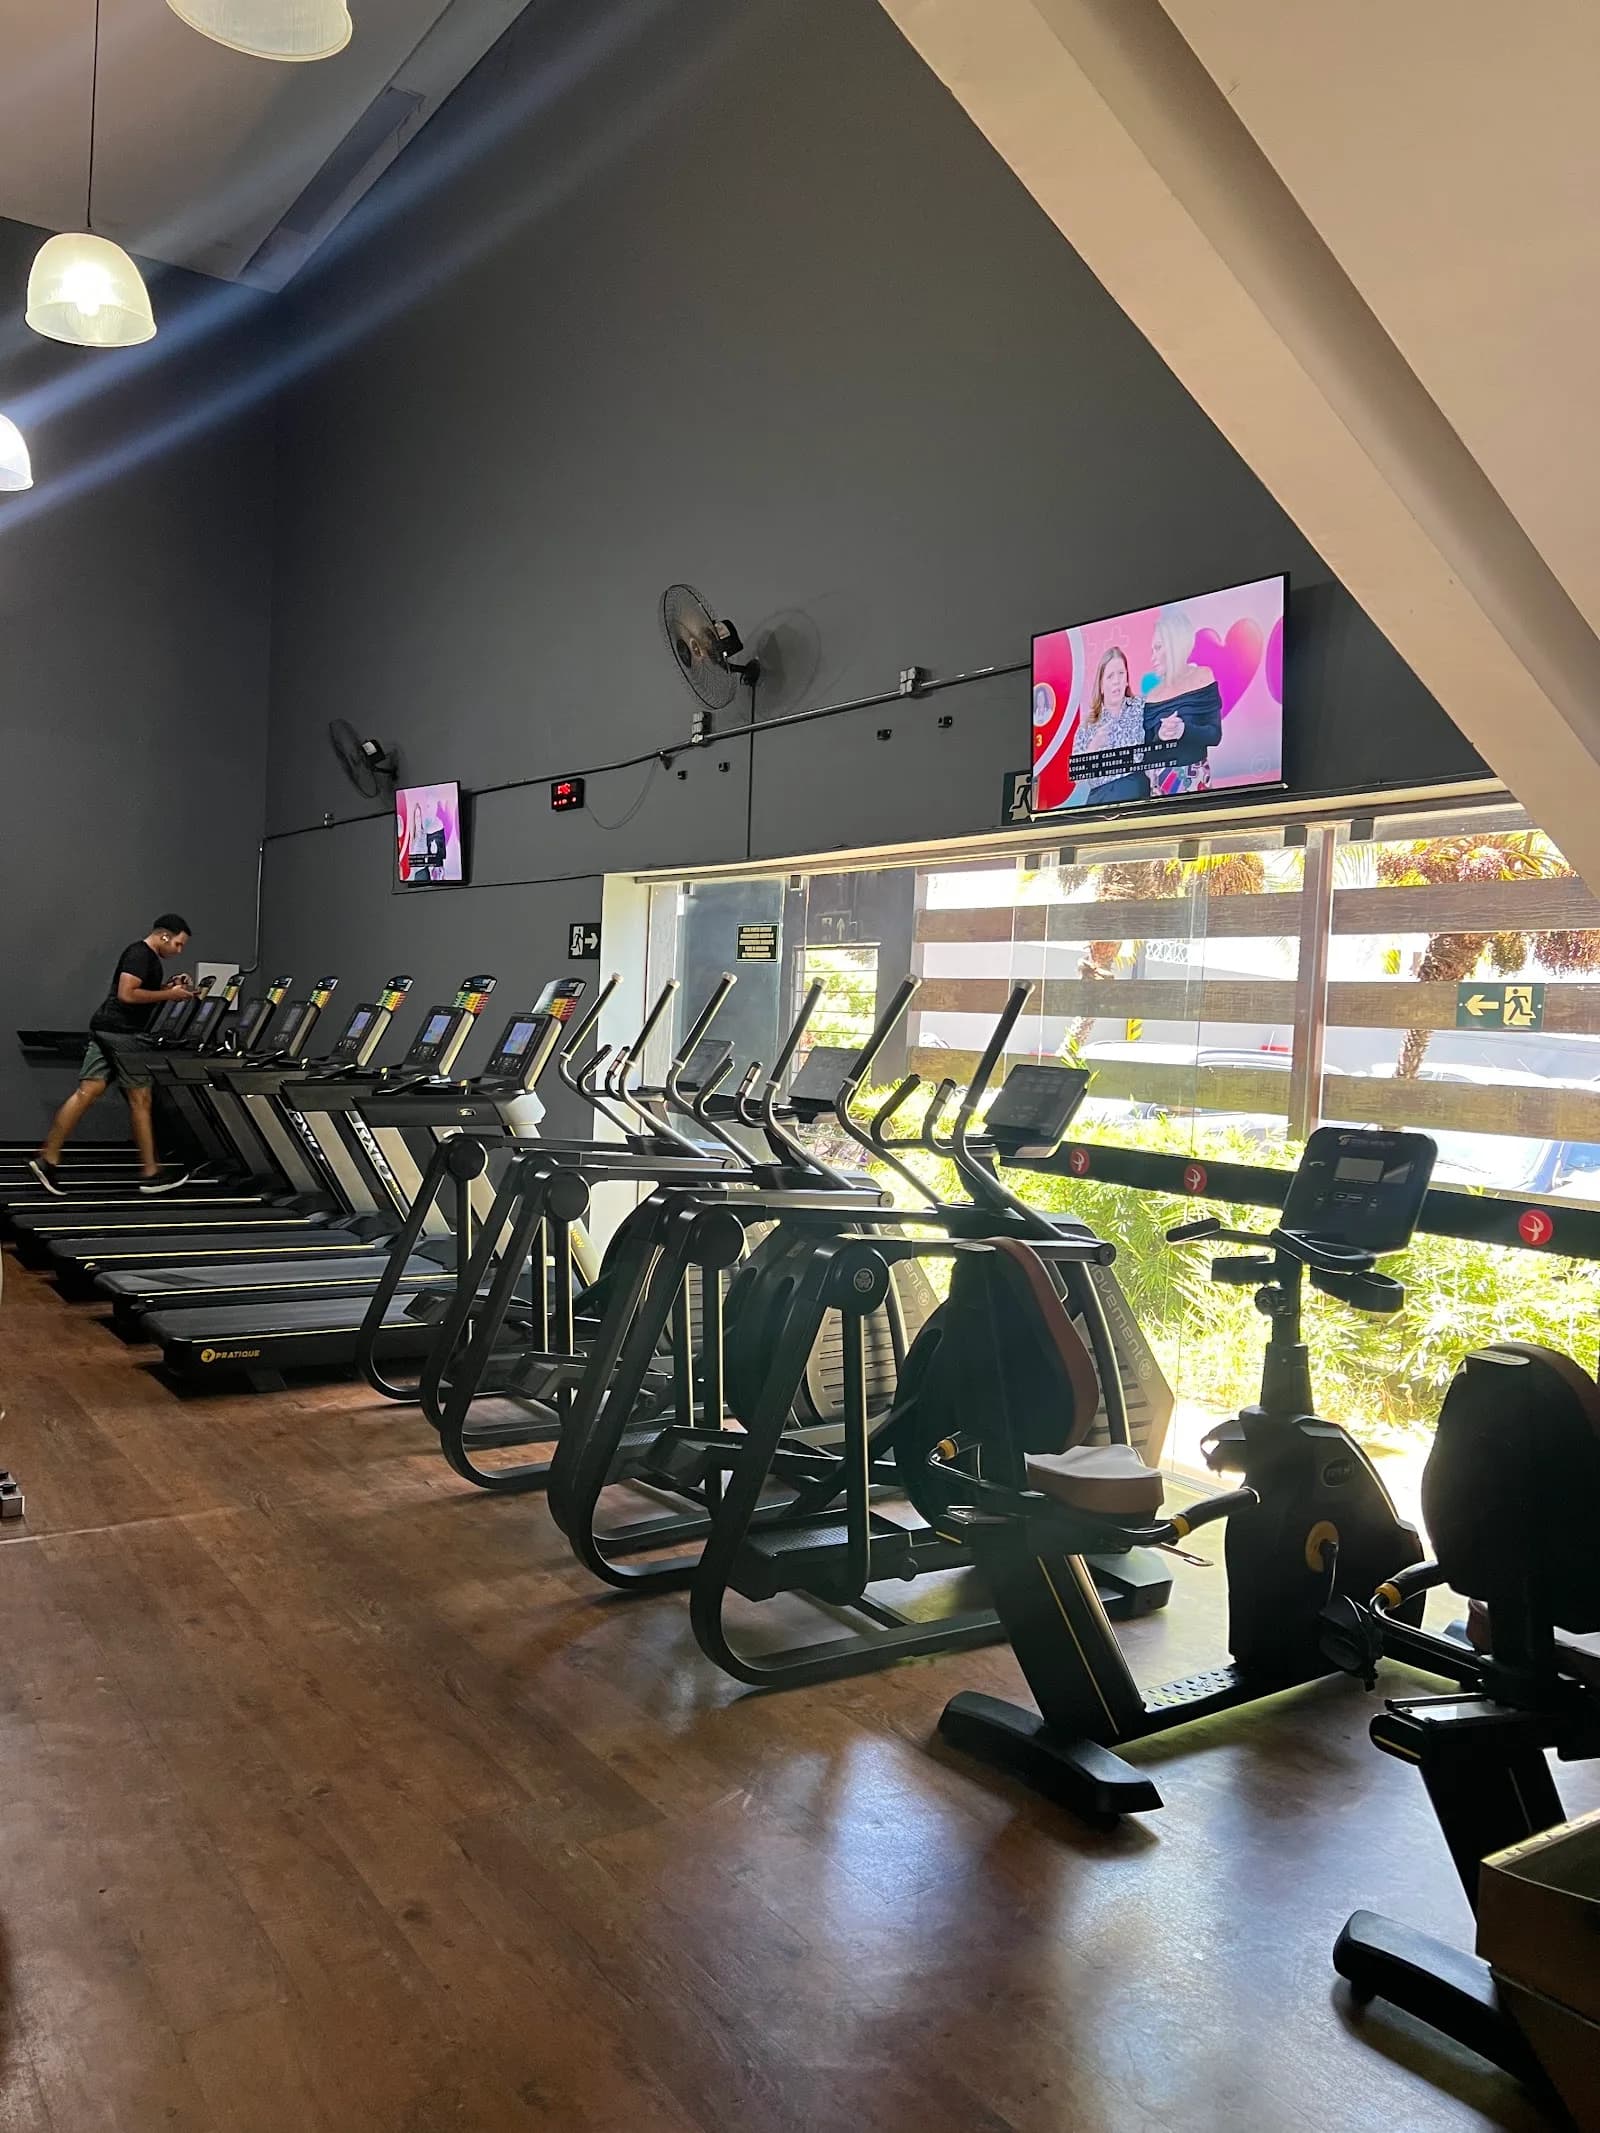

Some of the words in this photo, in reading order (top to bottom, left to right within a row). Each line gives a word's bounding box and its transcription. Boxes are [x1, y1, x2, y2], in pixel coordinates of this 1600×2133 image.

[1035, 734, 1043, 747] 3
[1102, 751, 1116, 759] CADA
[215, 1349, 261, 1360] PRATIQUE
